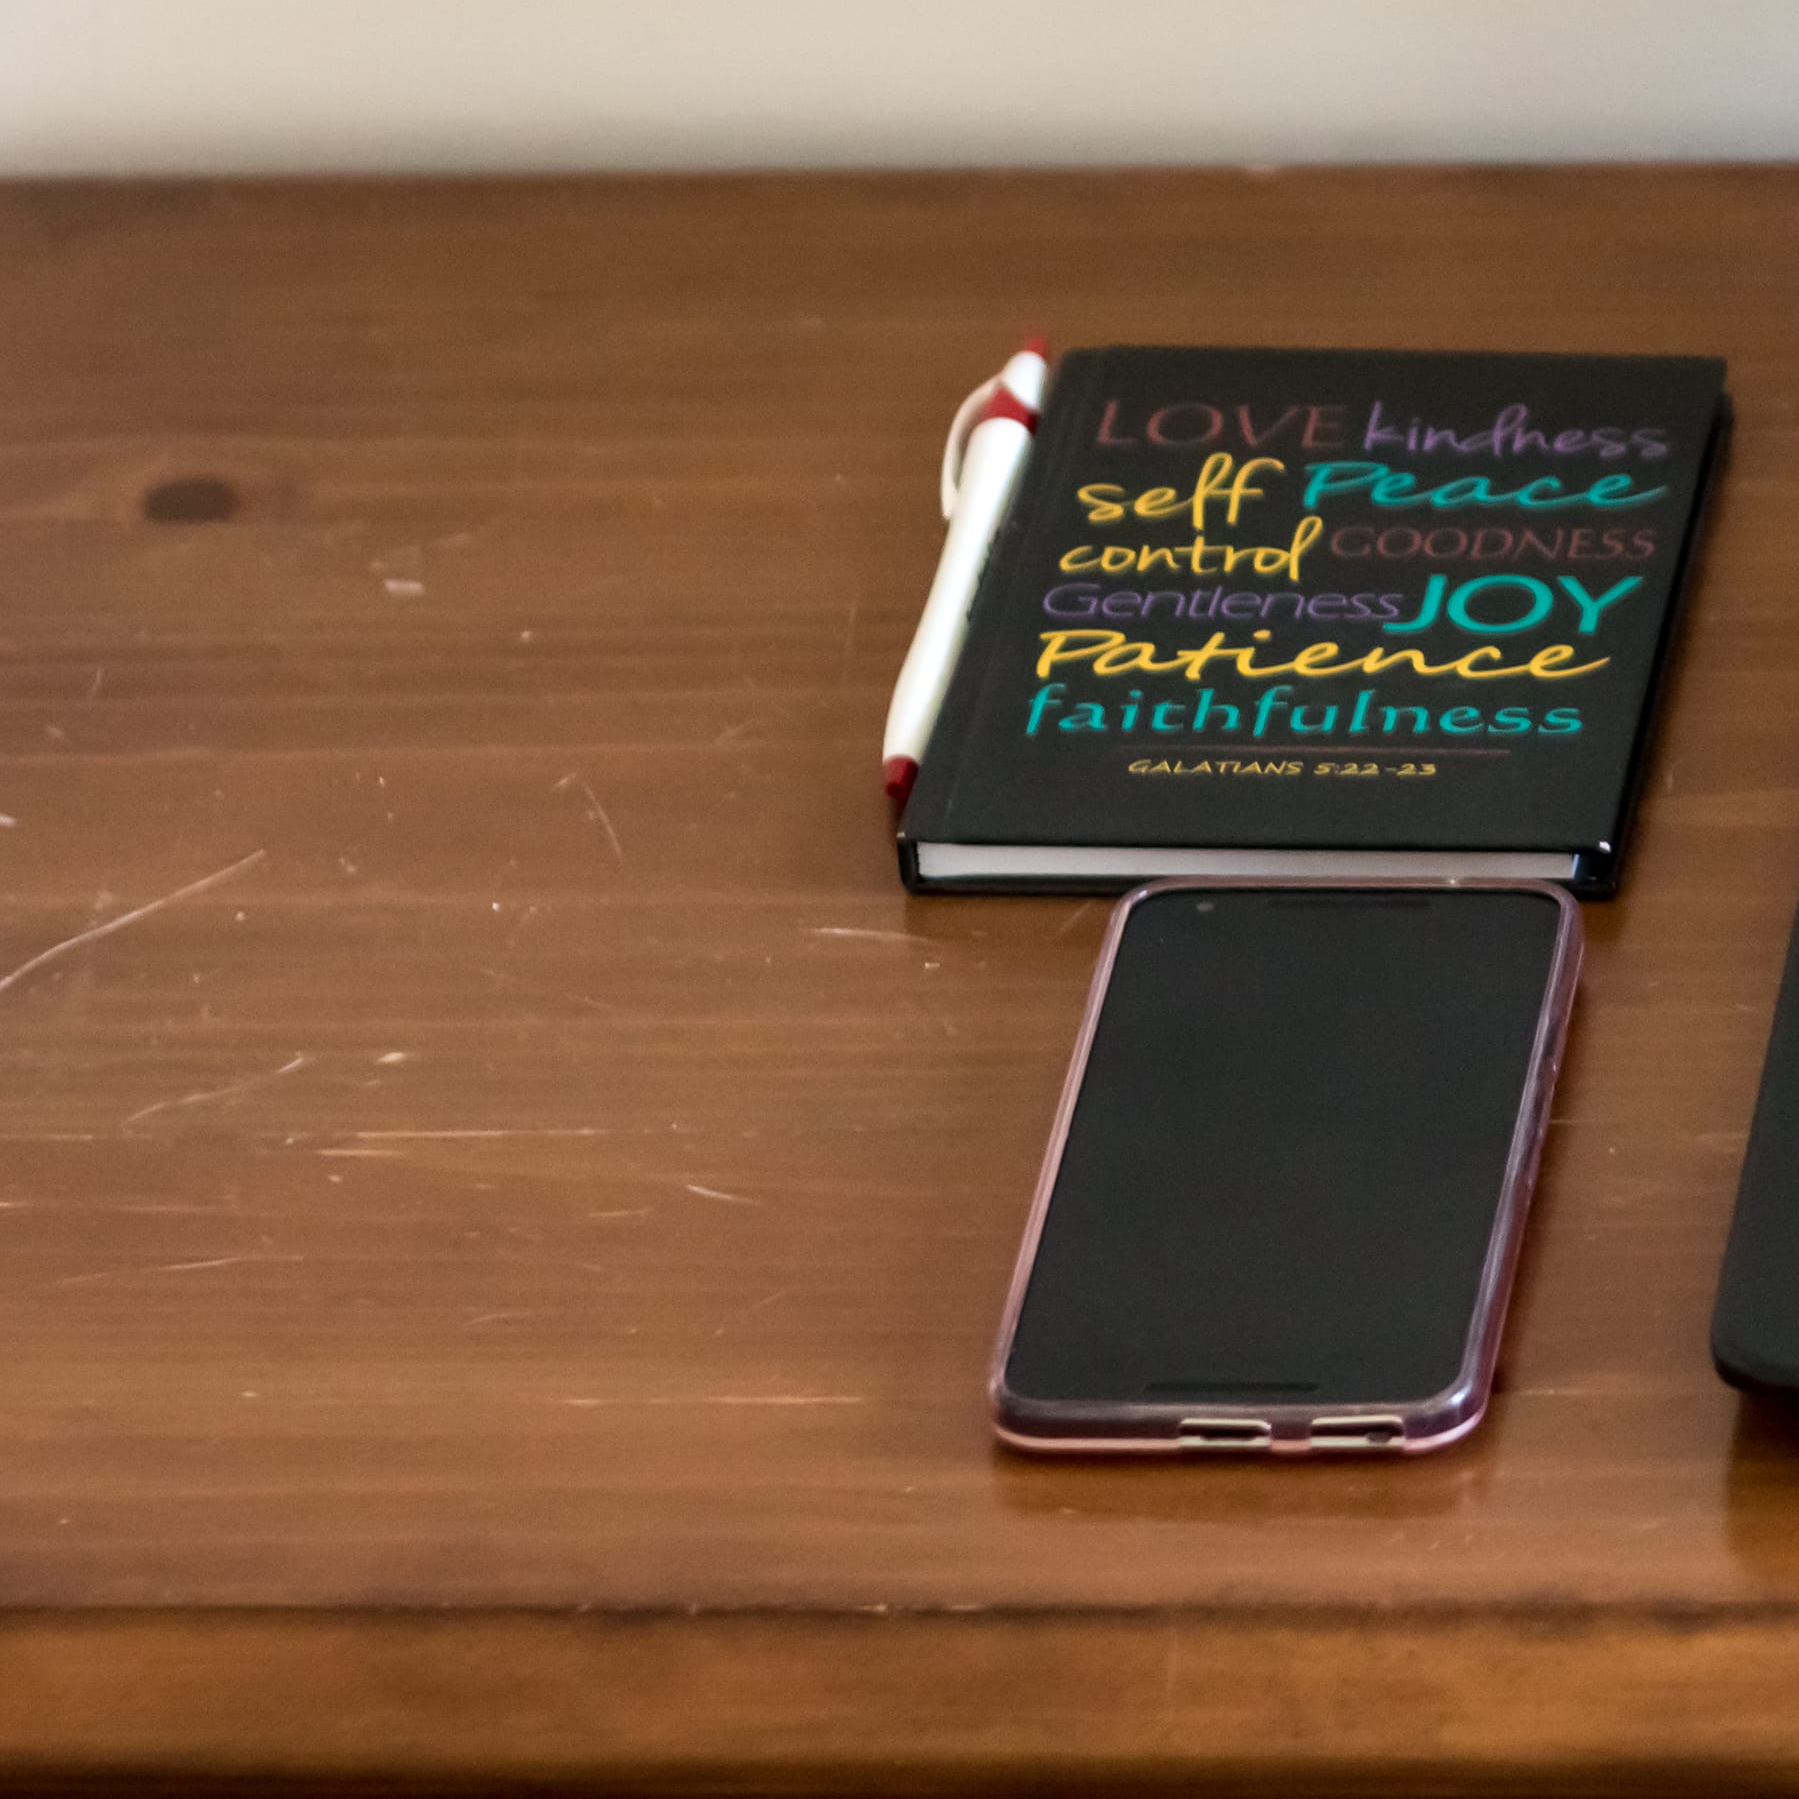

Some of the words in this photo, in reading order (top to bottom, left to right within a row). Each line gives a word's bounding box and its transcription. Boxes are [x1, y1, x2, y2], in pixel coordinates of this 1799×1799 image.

[1097, 400, 1347, 448] LOVE
[1364, 400, 1669, 458] kindness
[1077, 452, 1286, 530] self
[1304, 460, 1669, 509] Peace
[1059, 515, 1323, 582] control
[1330, 526, 1656, 561] GOODNESS
[1042, 583, 1403, 620] Gentleness
[1382, 574, 1643, 634] JOY
[1036, 628, 1610, 680] Patience
[1025, 683, 1584, 737] faithfulness
[1127, 759, 1303, 775] GALATIANS
